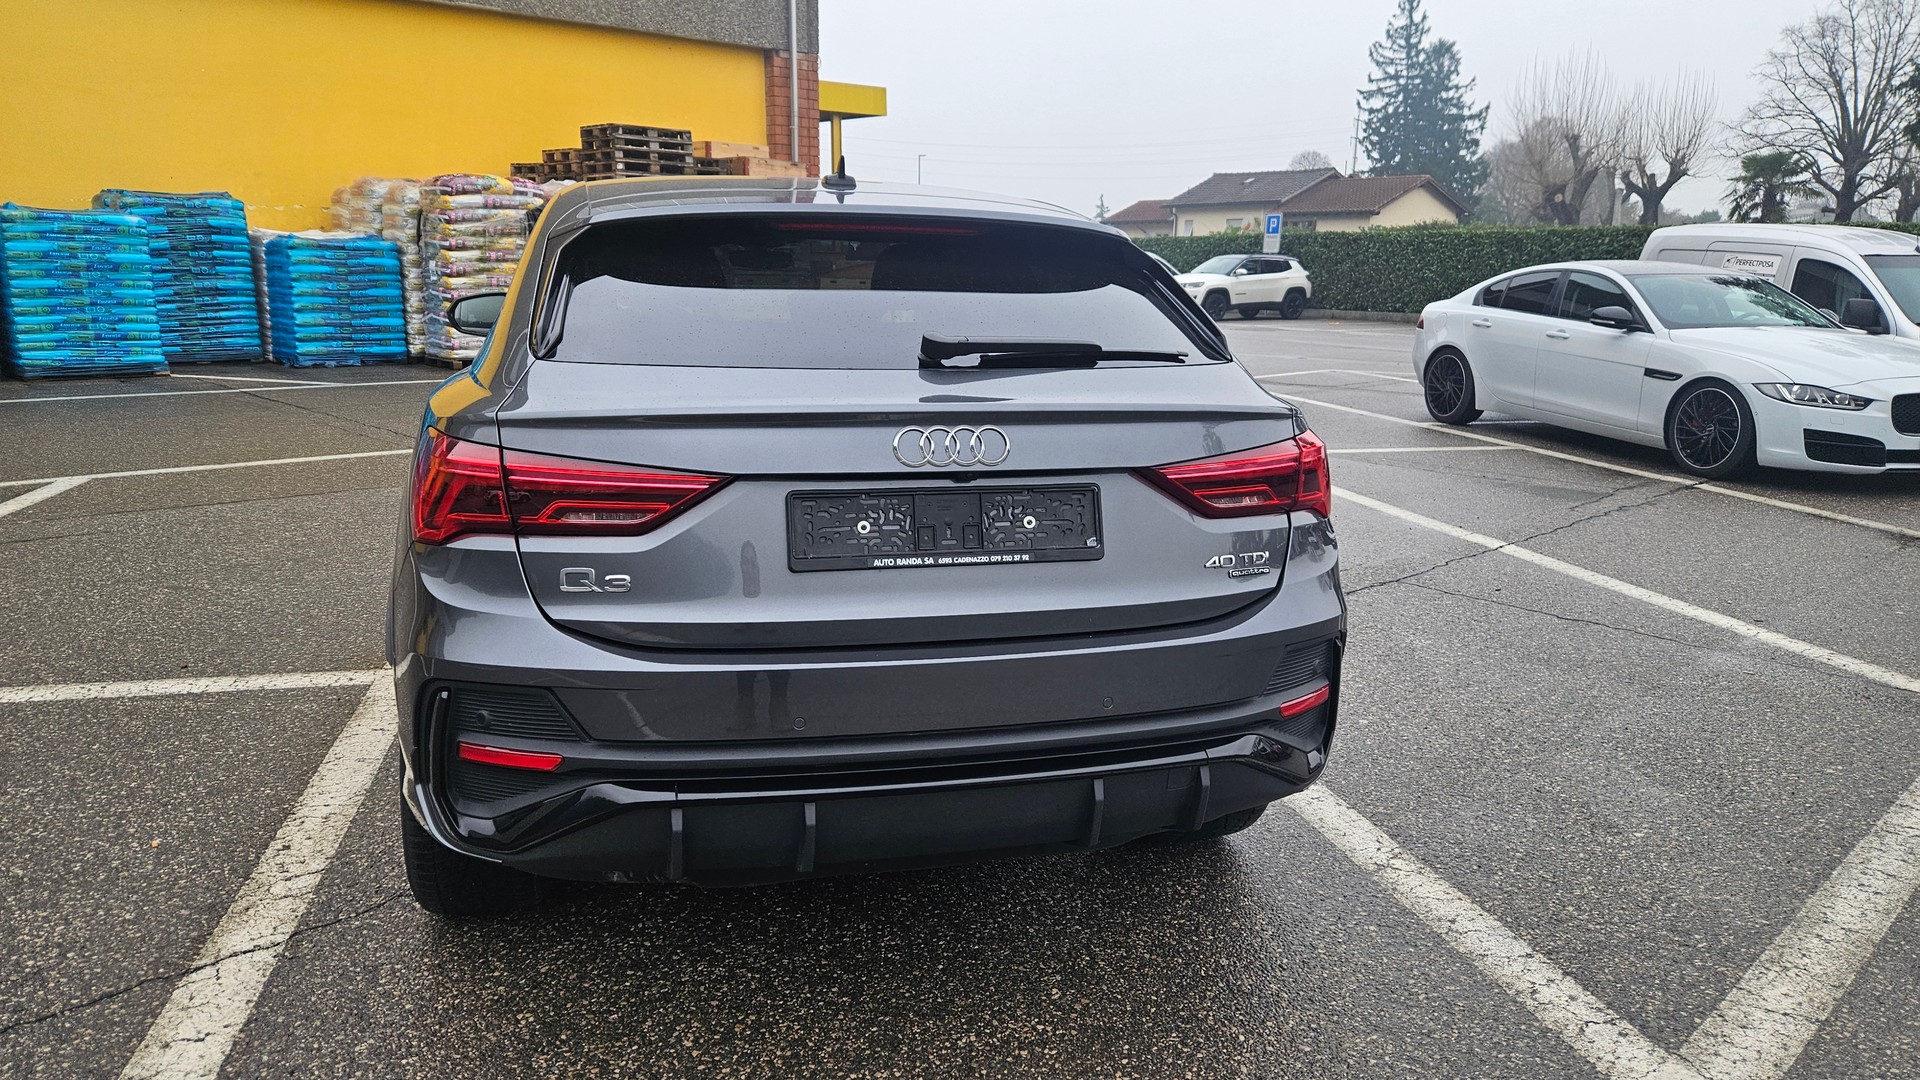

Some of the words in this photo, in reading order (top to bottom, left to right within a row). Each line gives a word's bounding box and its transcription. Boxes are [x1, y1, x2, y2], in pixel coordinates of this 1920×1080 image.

[1269, 218, 1277, 232] P
[1736, 258, 1774, 268] PERFECTPOSA
[873, 558, 894, 567] AUTO
[896, 557, 922, 566] RANDA
[924, 557, 934, 565] SA
[1204, 554, 1236, 569] 40
[1239, 551, 1269, 566] TDI
[1232, 567, 1269, 576] quattro
[560, 567, 631, 592] Q3
